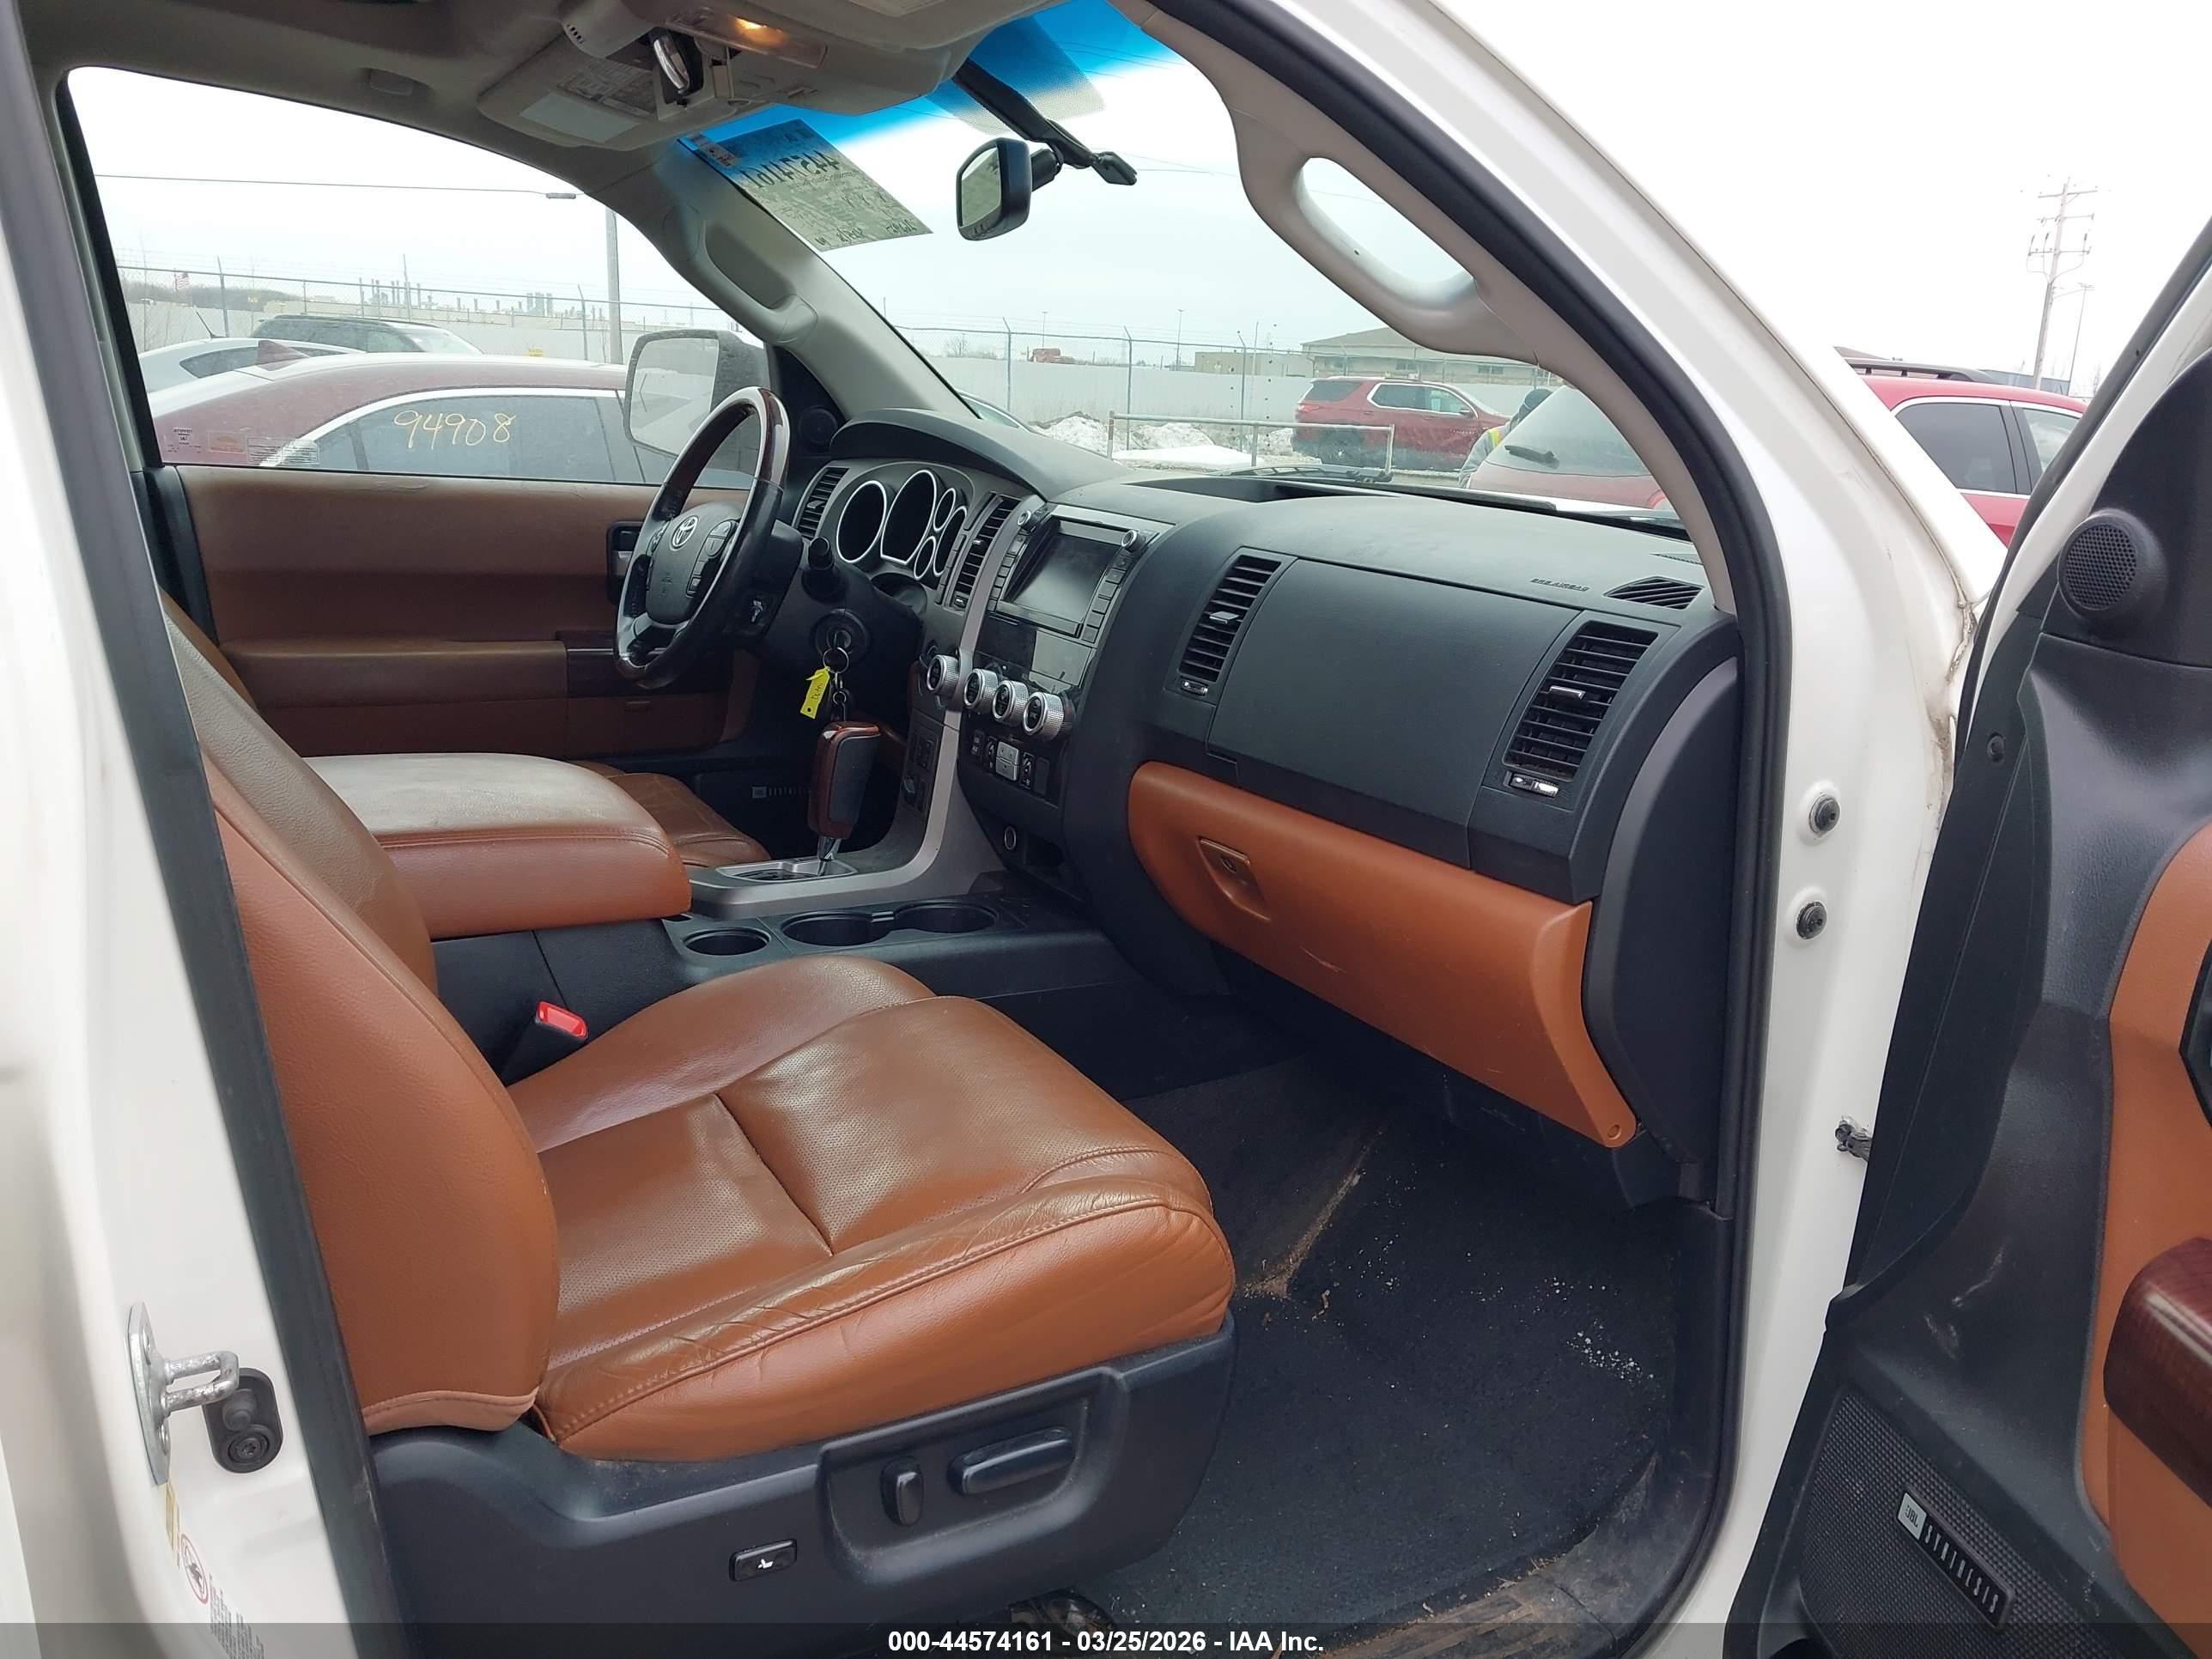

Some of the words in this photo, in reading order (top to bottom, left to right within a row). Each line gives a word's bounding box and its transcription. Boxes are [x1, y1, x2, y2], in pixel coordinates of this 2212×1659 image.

[394, 410, 517, 450] 94908
[1553, 582, 1590, 592] AIRBAG
[1923, 1524, 1999, 1613] SYNTHESIS
